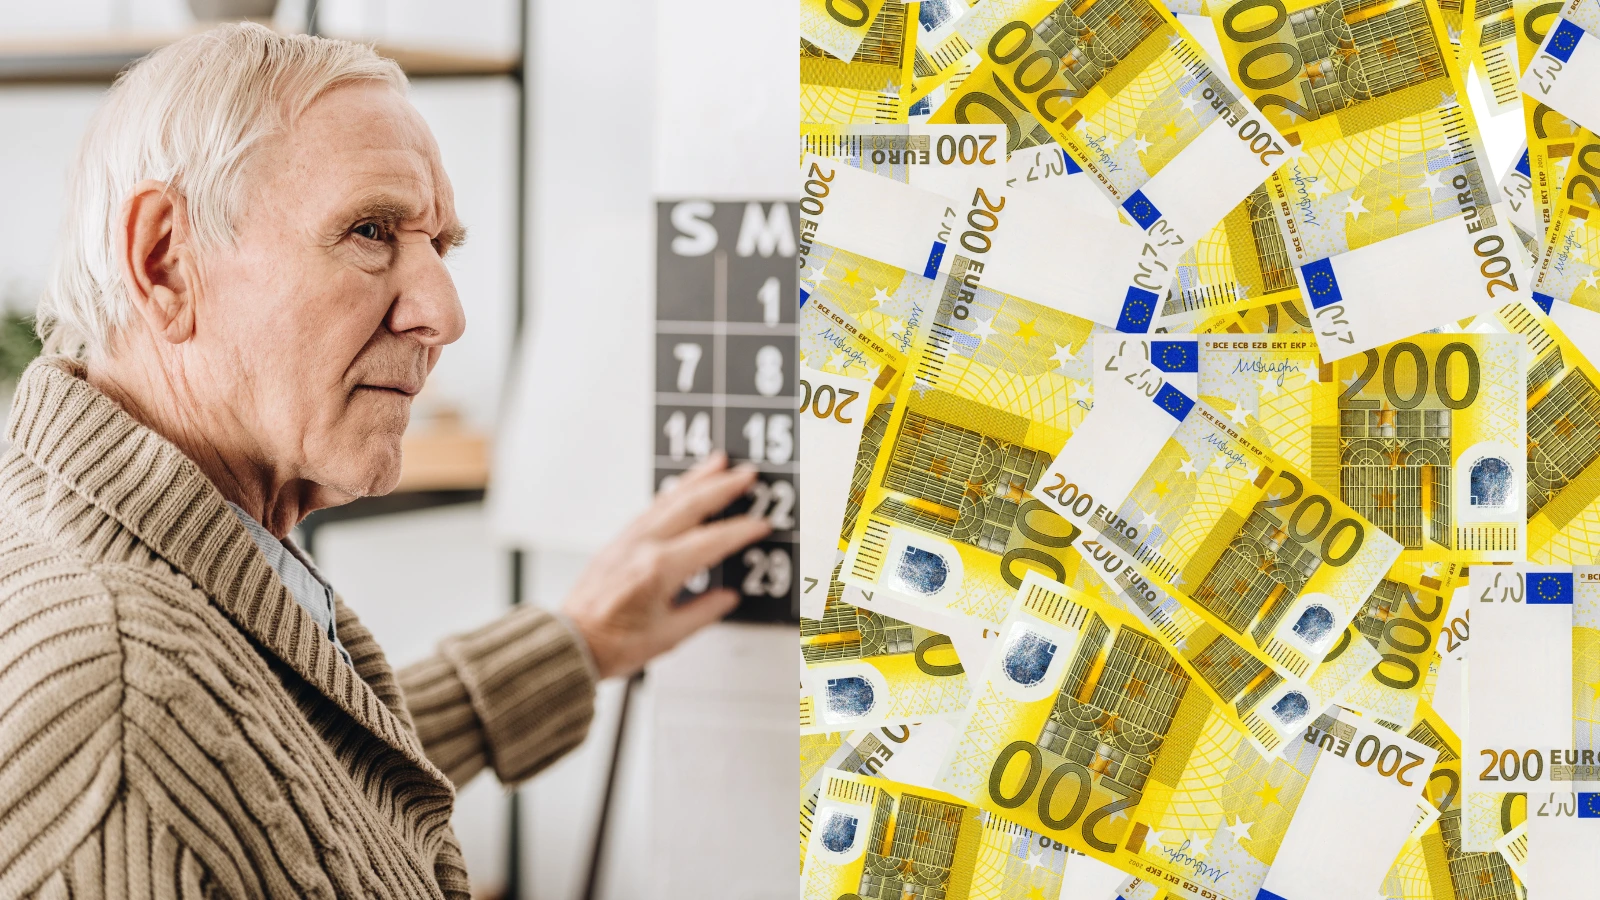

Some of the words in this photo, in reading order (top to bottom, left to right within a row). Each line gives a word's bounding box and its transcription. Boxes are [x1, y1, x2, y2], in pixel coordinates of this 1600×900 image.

[988, 21, 1088, 123] 200
[1223, 0, 1320, 121] 200
[1202, 87, 1240, 128] EURO
[871, 150, 930, 165] EURO
[936, 134, 997, 165] 200
[1077, 152, 1088, 163] EKT
[1238, 119, 1285, 167] 200
[800, 162, 835, 216] 200
[1087, 162, 1098, 174] EZB
[1097, 173, 1108, 185] ECB
[1274, 183, 1285, 198] EKT
[1539, 171, 1547, 187] EKP
[960, 187, 1005, 254] 200
[1280, 201, 1290, 216] EZB
[1452, 174, 1483, 234] EURO
[1541, 190, 1549, 205] EKT
[670, 202, 719, 257] S
[736, 202, 797, 258] M
[1286, 218, 1296, 234] ECB
[1292, 237, 1302, 252] BCE
[953, 259, 985, 321] EURO
[1473, 234, 1519, 298] 200
[757, 276, 781, 328] 1
[817, 303, 831, 315] BCE
[831, 313, 844, 325] ECB
[844, 323, 857, 335] EZB
[858, 333, 871, 344] EKT
[871, 342, 884, 353] EKP
[673, 342, 702, 393] 7
[755, 345, 784, 397] 8
[1338, 341, 1480, 410] 200
[664, 411, 712, 462] 14
[743, 413, 794, 465] 15
[1202, 410, 1214, 421] BCE
[1214, 419, 1227, 430] ECB
[1226, 428, 1239, 438] EZB
[1239, 437, 1251, 448] EKT
[1250, 446, 1263, 456] EKP
[749, 480, 795, 531] 22
[1042, 472, 1093, 517] 200
[1094, 504, 1138, 539] EURO
[1253, 470, 1364, 567] 200
[743, 548, 792, 599] 29
[1122, 565, 1156, 602] EURO
[1372, 582, 1443, 690] 200
[1440, 609, 1469, 653] 20
[1355, 734, 1425, 787] 200
[1479, 748, 1543, 781] 200
[1550, 750, 1600, 765] EUR
[988, 740, 1143, 854] 200
[1145, 865, 1162, 877] EKP
[1164, 874, 1180, 885] EKT
[1183, 881, 1198, 893] EZB
